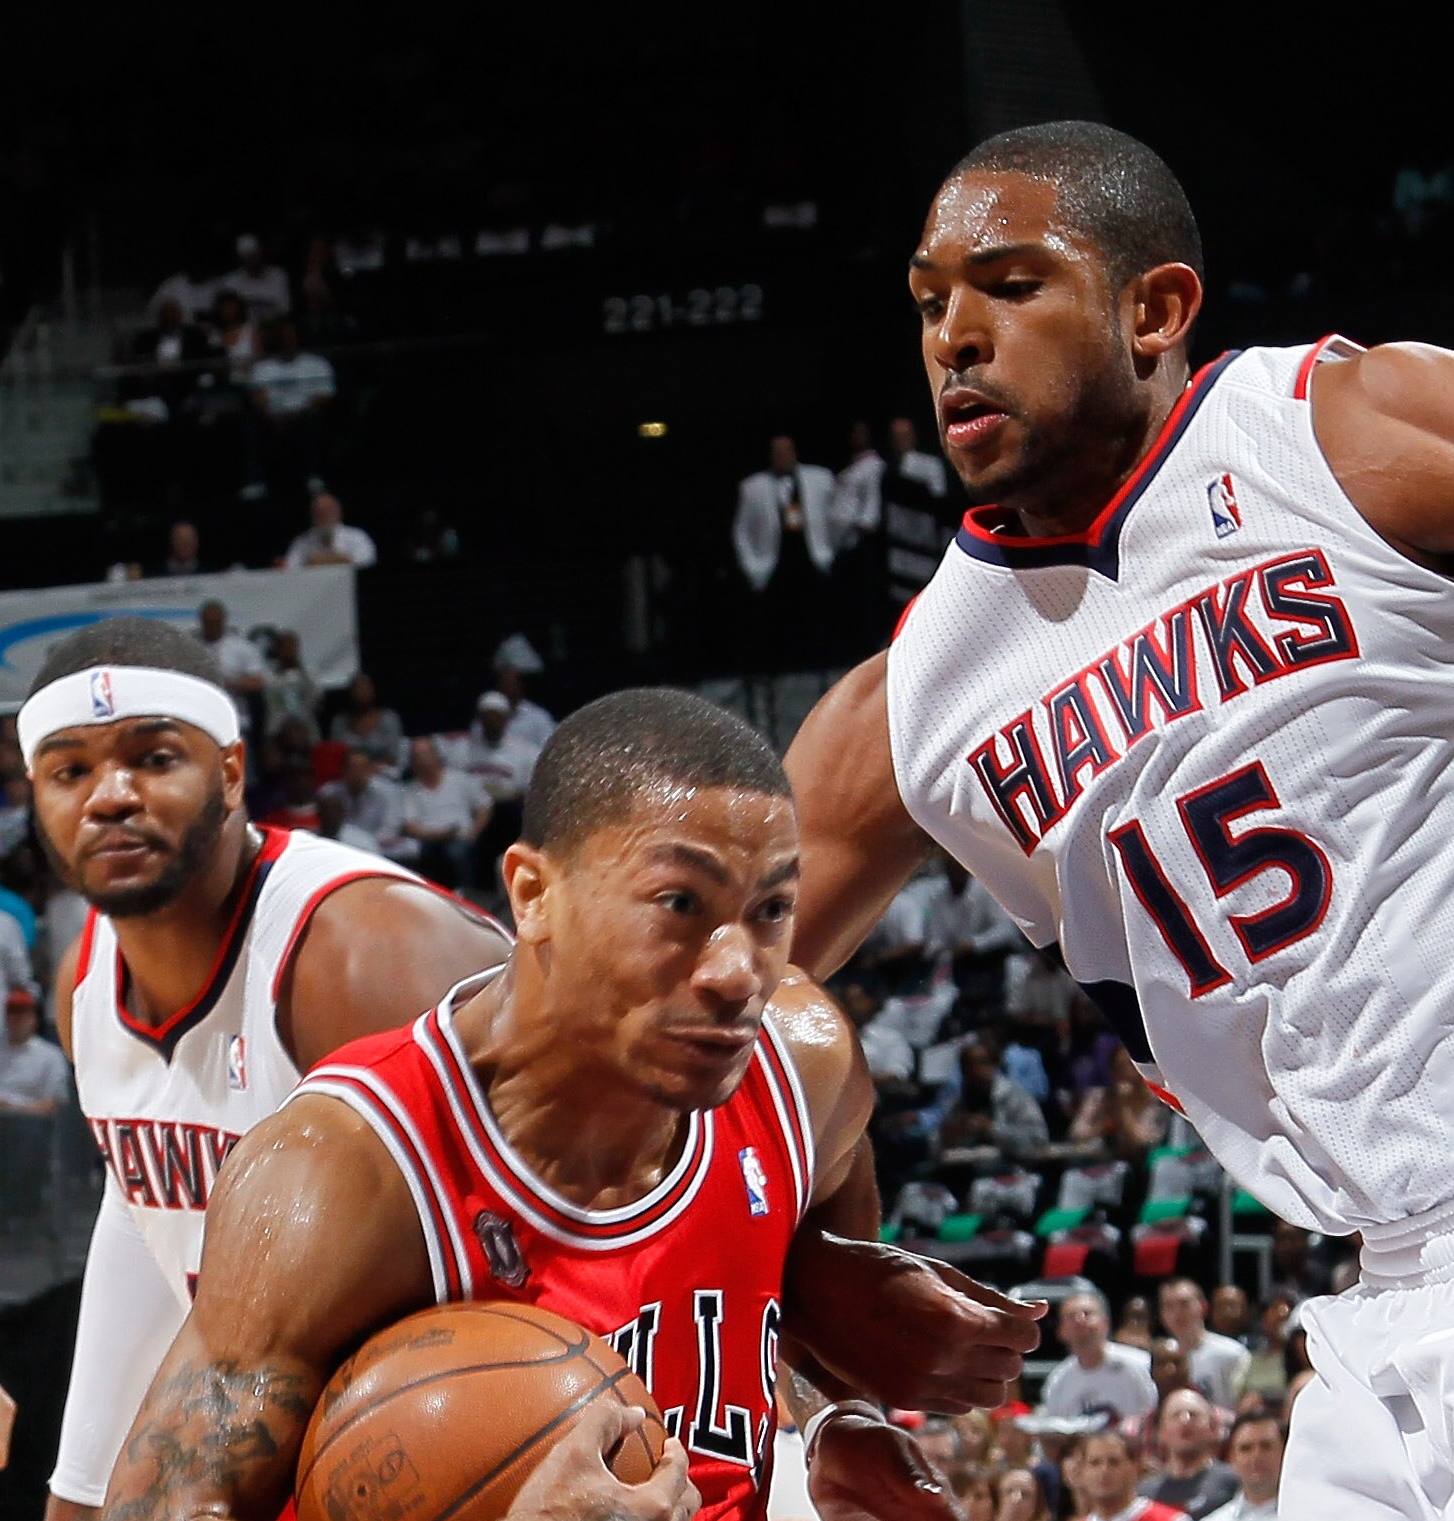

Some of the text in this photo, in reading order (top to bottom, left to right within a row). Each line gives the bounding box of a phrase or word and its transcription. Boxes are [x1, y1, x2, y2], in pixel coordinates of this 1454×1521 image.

[603, 283, 763, 334] 221-222
[967, 548, 1359, 857] HAWKS
[1108, 761, 1333, 998] 15
